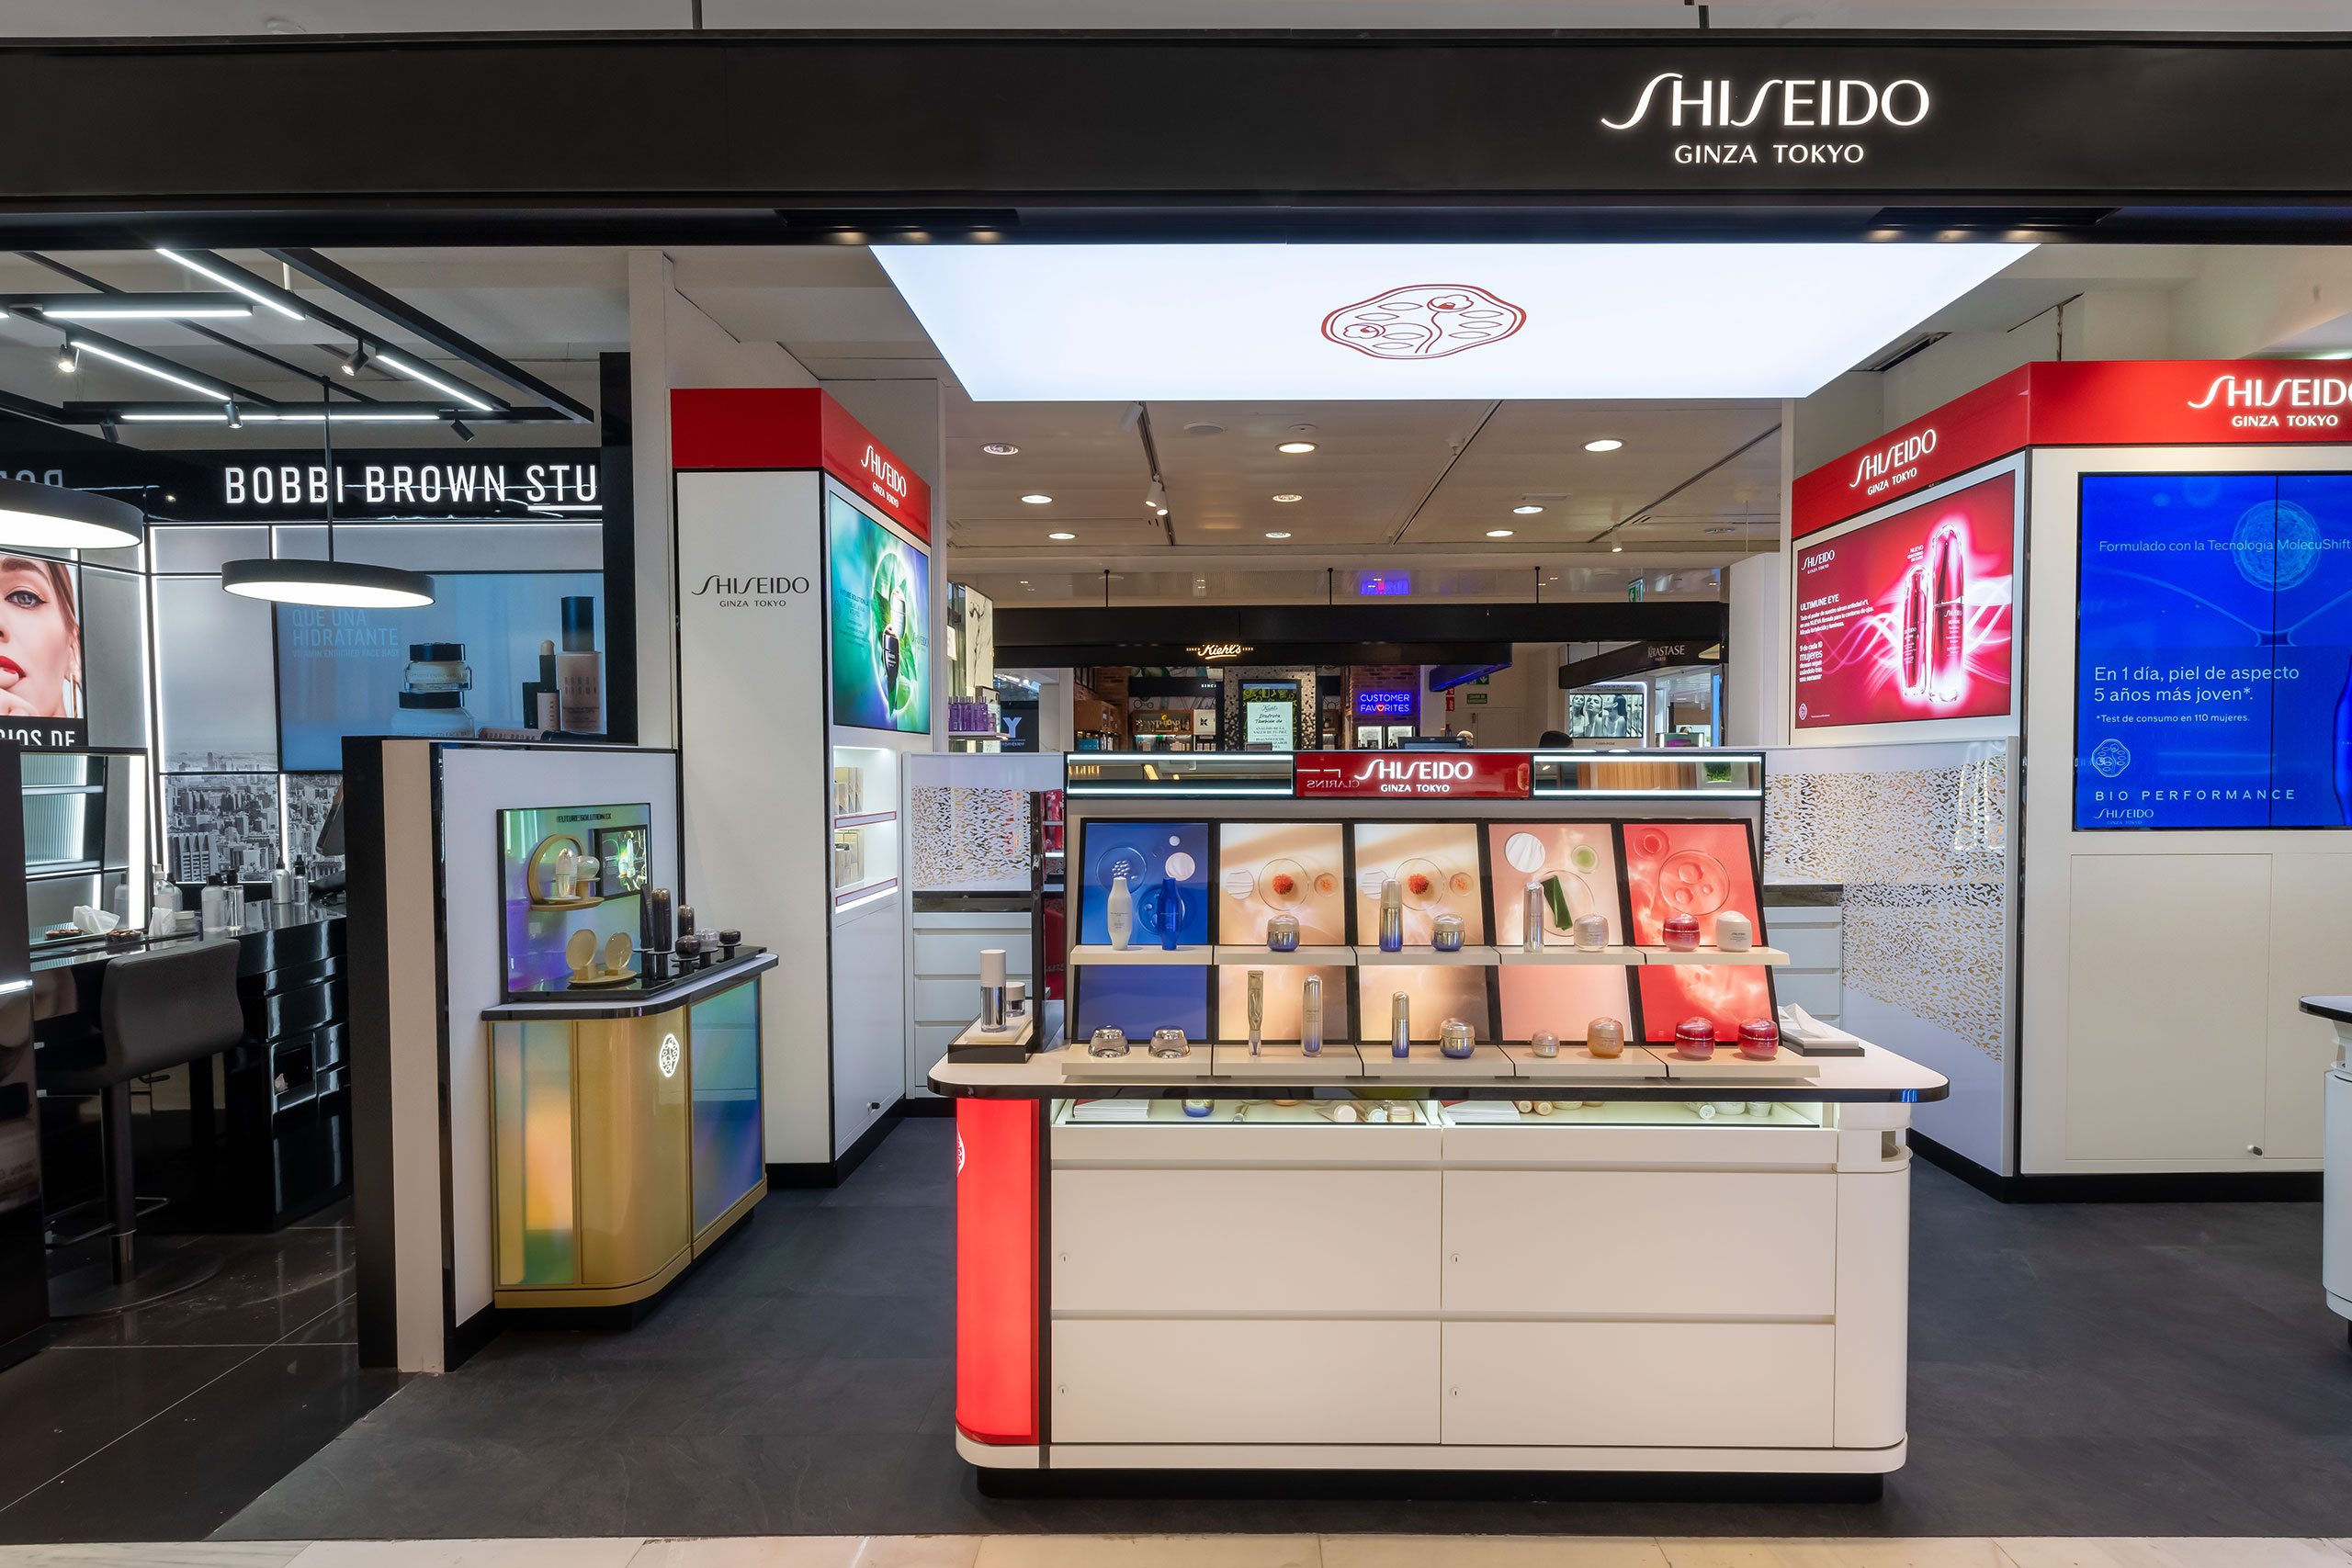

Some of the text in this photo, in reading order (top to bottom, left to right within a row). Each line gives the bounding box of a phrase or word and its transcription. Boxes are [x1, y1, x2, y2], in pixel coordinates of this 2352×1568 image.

[1600, 73, 1930, 130] SHISEIDO
[1674, 143, 1865, 164] GINZA TOKYO
[2232, 415, 2339, 427] GINZA TOKYO
[1849, 428, 1937, 488] SHISEIDO
[860, 445, 907, 498] SHISEIDO
[224, 464, 597, 504] BOBBI BROWN STU
[1867, 468, 1917, 496] GINZA TOKYO
[872, 481, 899, 508] GINZA TOKYO
[2099, 538, 2351, 553] Formulado con la Tecnología MolecuShift
[1801, 549, 1836, 570] SHISEIDO
[691, 574, 810, 596] SHISEIDO
[719, 600, 750, 608] GINZA
[1800, 593, 1839, 611] ULTIMUNE EYE
[292, 609, 368, 626] QUE UNA
[293, 628, 398, 647] HIDRATANTE
[1197, 644, 1241, 658] Kiehl's
[1799, 650, 1823, 662] mujeres
[2095, 665, 2300, 682] En 1 día, piel de aspecto
[1360, 694, 1410, 703] CUSTOMER
[2094, 688, 2105, 702] 5
[2109, 688, 2151, 702] años
[2156, 686, 2191, 701] más
[2122, 715, 2133, 723] de
[2195, 714, 2209, 722] 110
[2211, 714, 2250, 724] mujeres.
[1354, 759, 1474, 781] SHISEIDO
[1380, 784, 1451, 794] GINZA TOKYO
[2095, 789, 2295, 801] BIO PERFORMANCE
[2094, 807, 2154, 819] SHISEIDO
